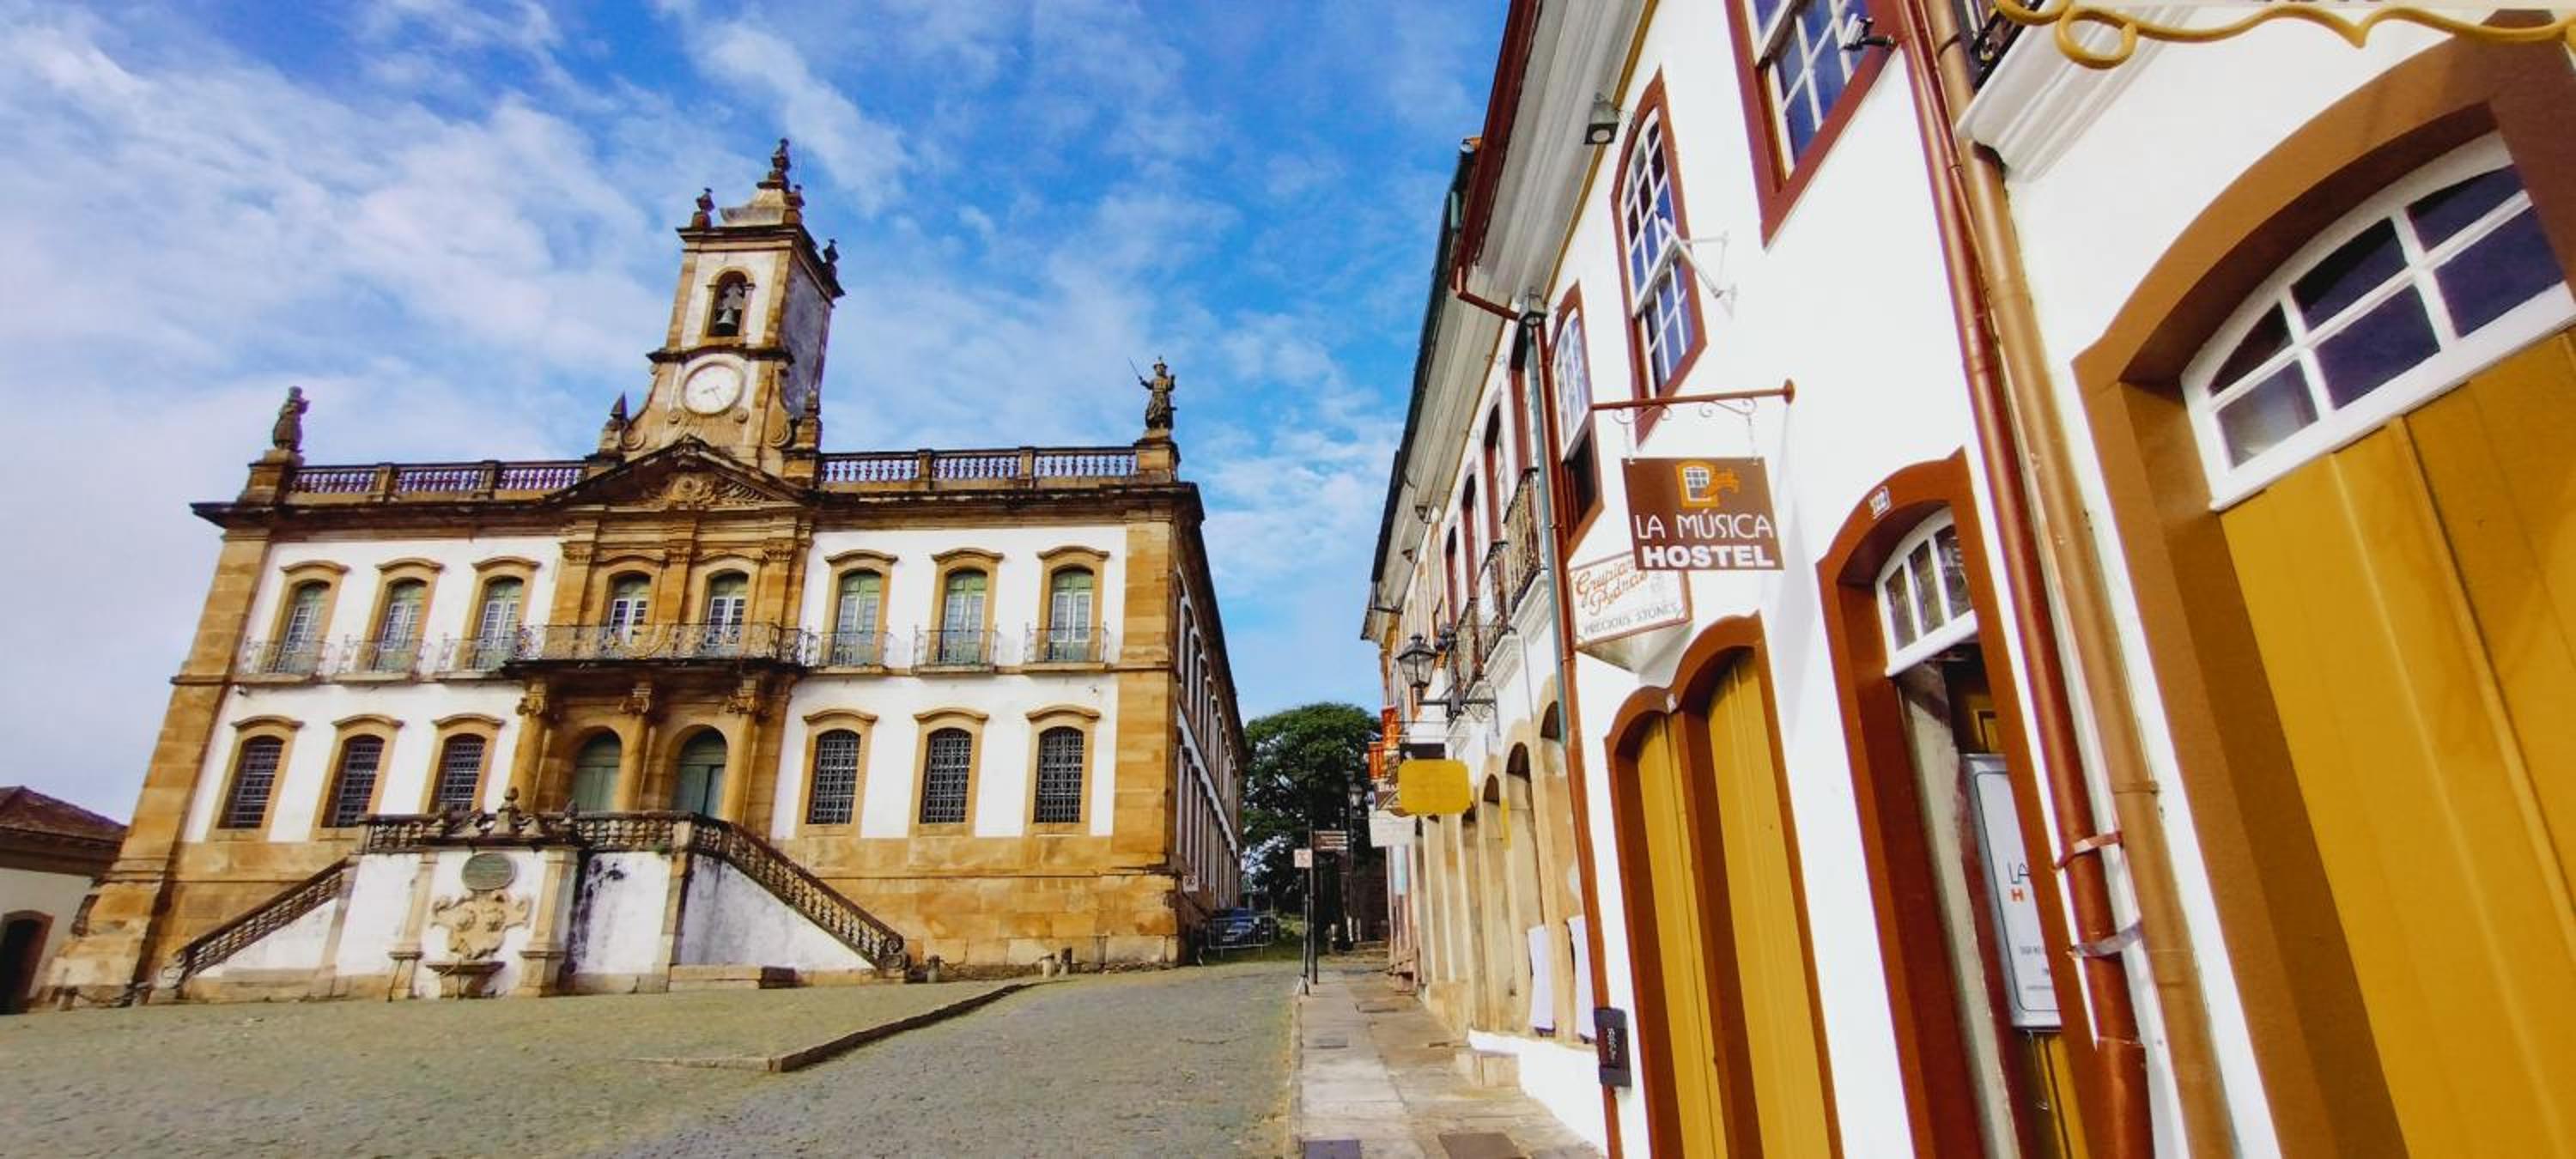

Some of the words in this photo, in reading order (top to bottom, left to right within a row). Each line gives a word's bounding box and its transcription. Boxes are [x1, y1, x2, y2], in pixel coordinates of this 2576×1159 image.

[1635, 514, 1666, 540] LA
[1676, 508, 1773, 539] MÚSICA
[1642, 544, 1775, 568] HOSTEL
